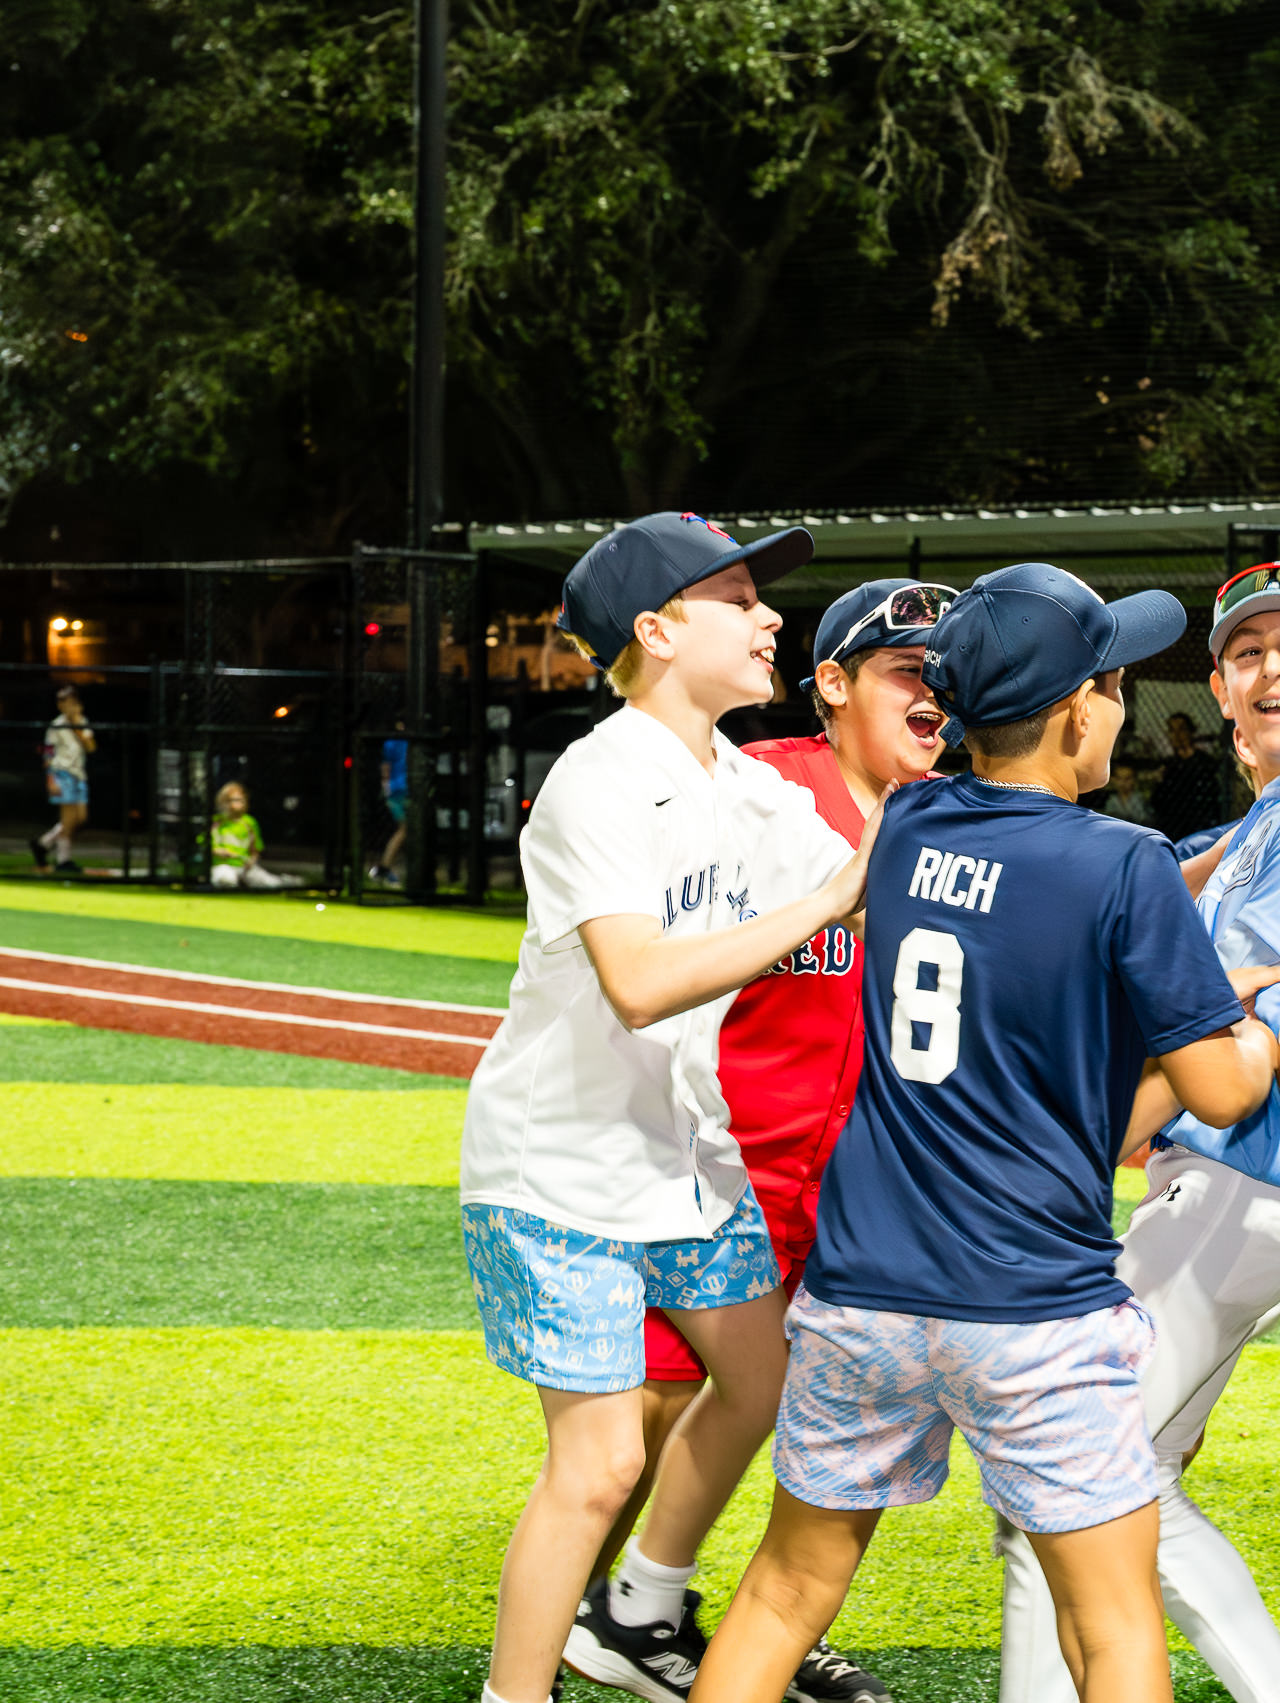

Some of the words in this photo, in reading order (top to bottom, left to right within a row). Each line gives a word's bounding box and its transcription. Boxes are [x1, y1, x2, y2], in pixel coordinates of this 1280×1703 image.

[908, 846, 1004, 914] RICH
[762, 923, 857, 977] ED
[890, 927, 965, 1085] 8
